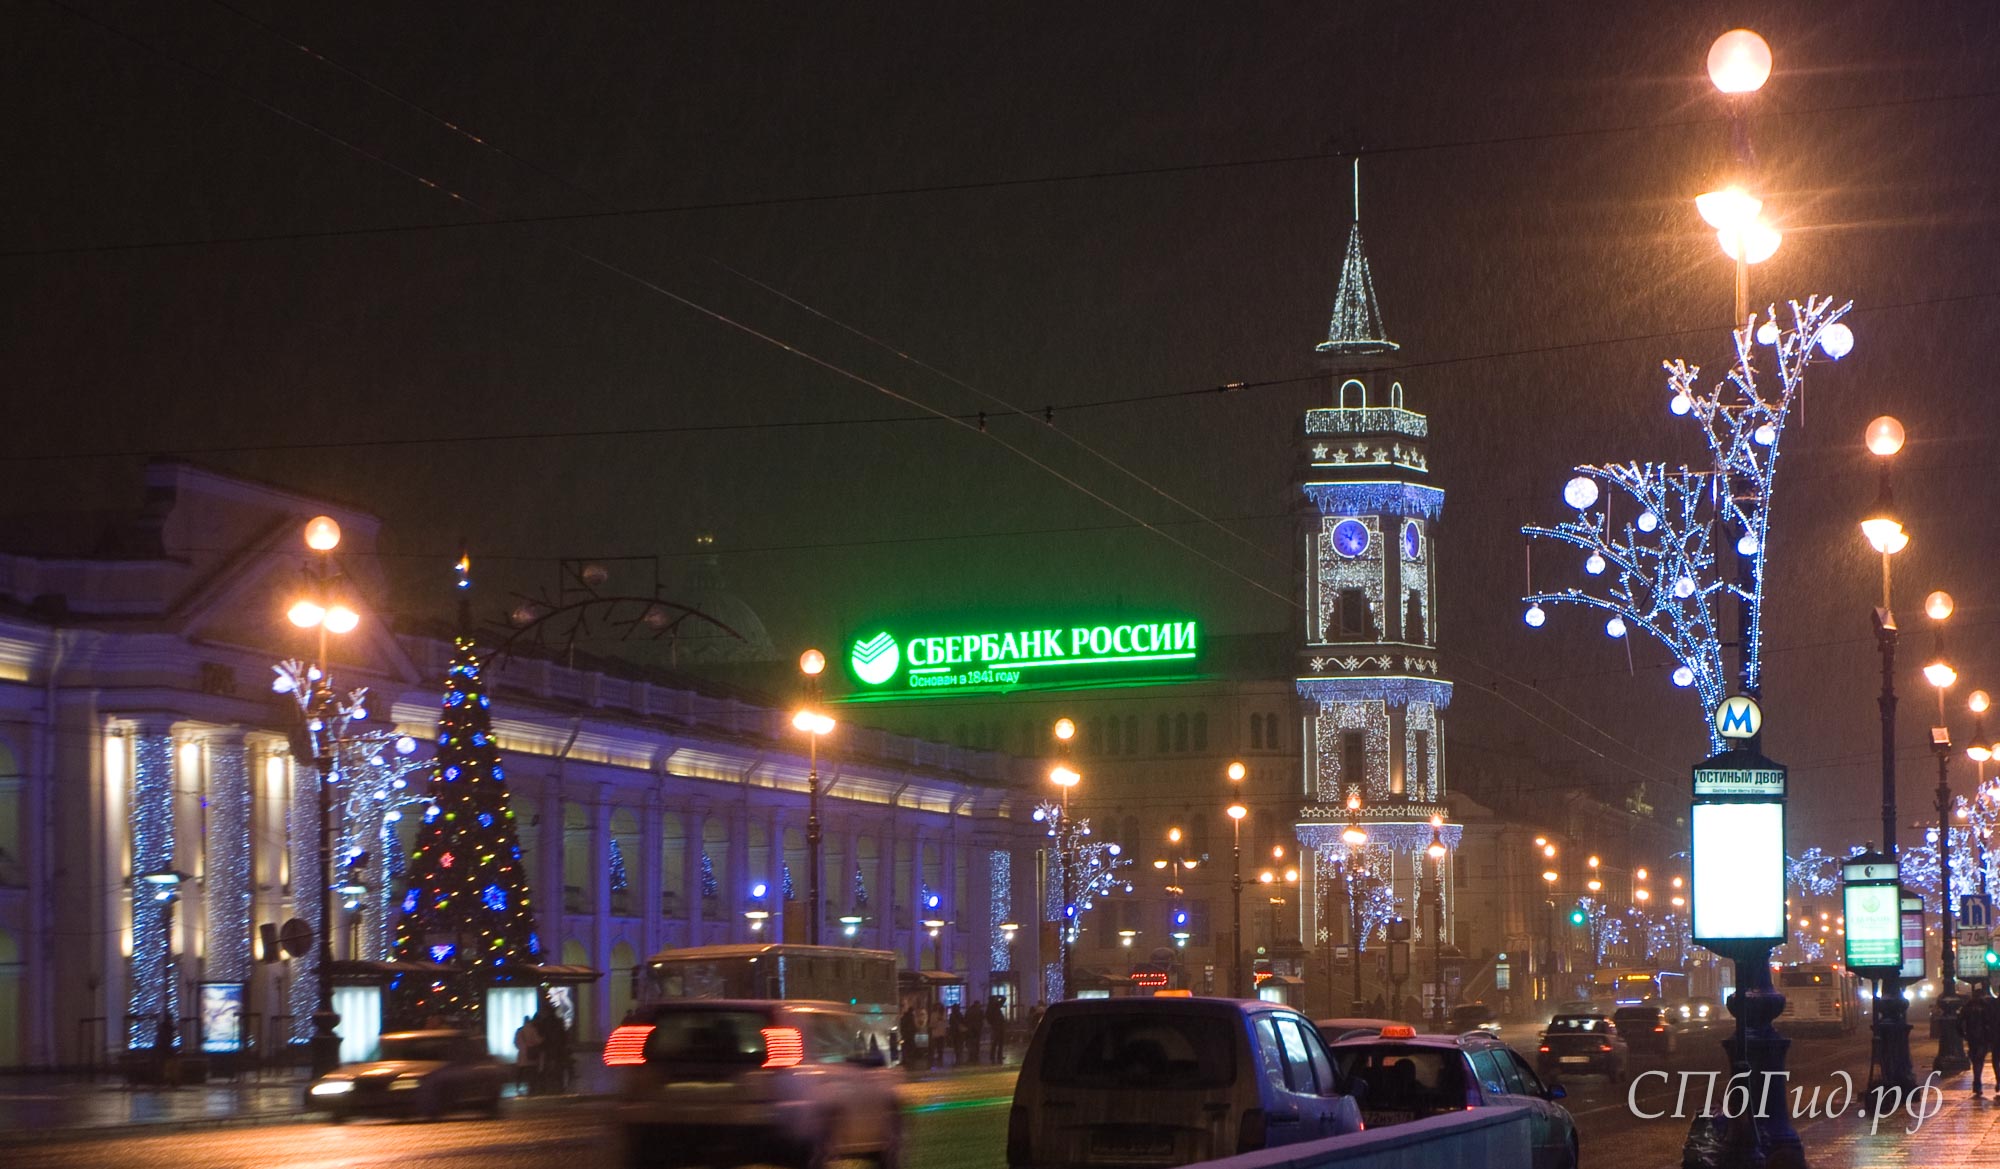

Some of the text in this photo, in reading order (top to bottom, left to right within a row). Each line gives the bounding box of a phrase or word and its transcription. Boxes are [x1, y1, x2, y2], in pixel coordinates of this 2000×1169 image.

[907, 622, 1196, 666] СБЕРБАНК РОССИИ
[909, 671, 1020, 687] Основан в 1841 году
[1722, 703, 1752, 733] М
[1755, 772, 1784, 784] ДВОР
